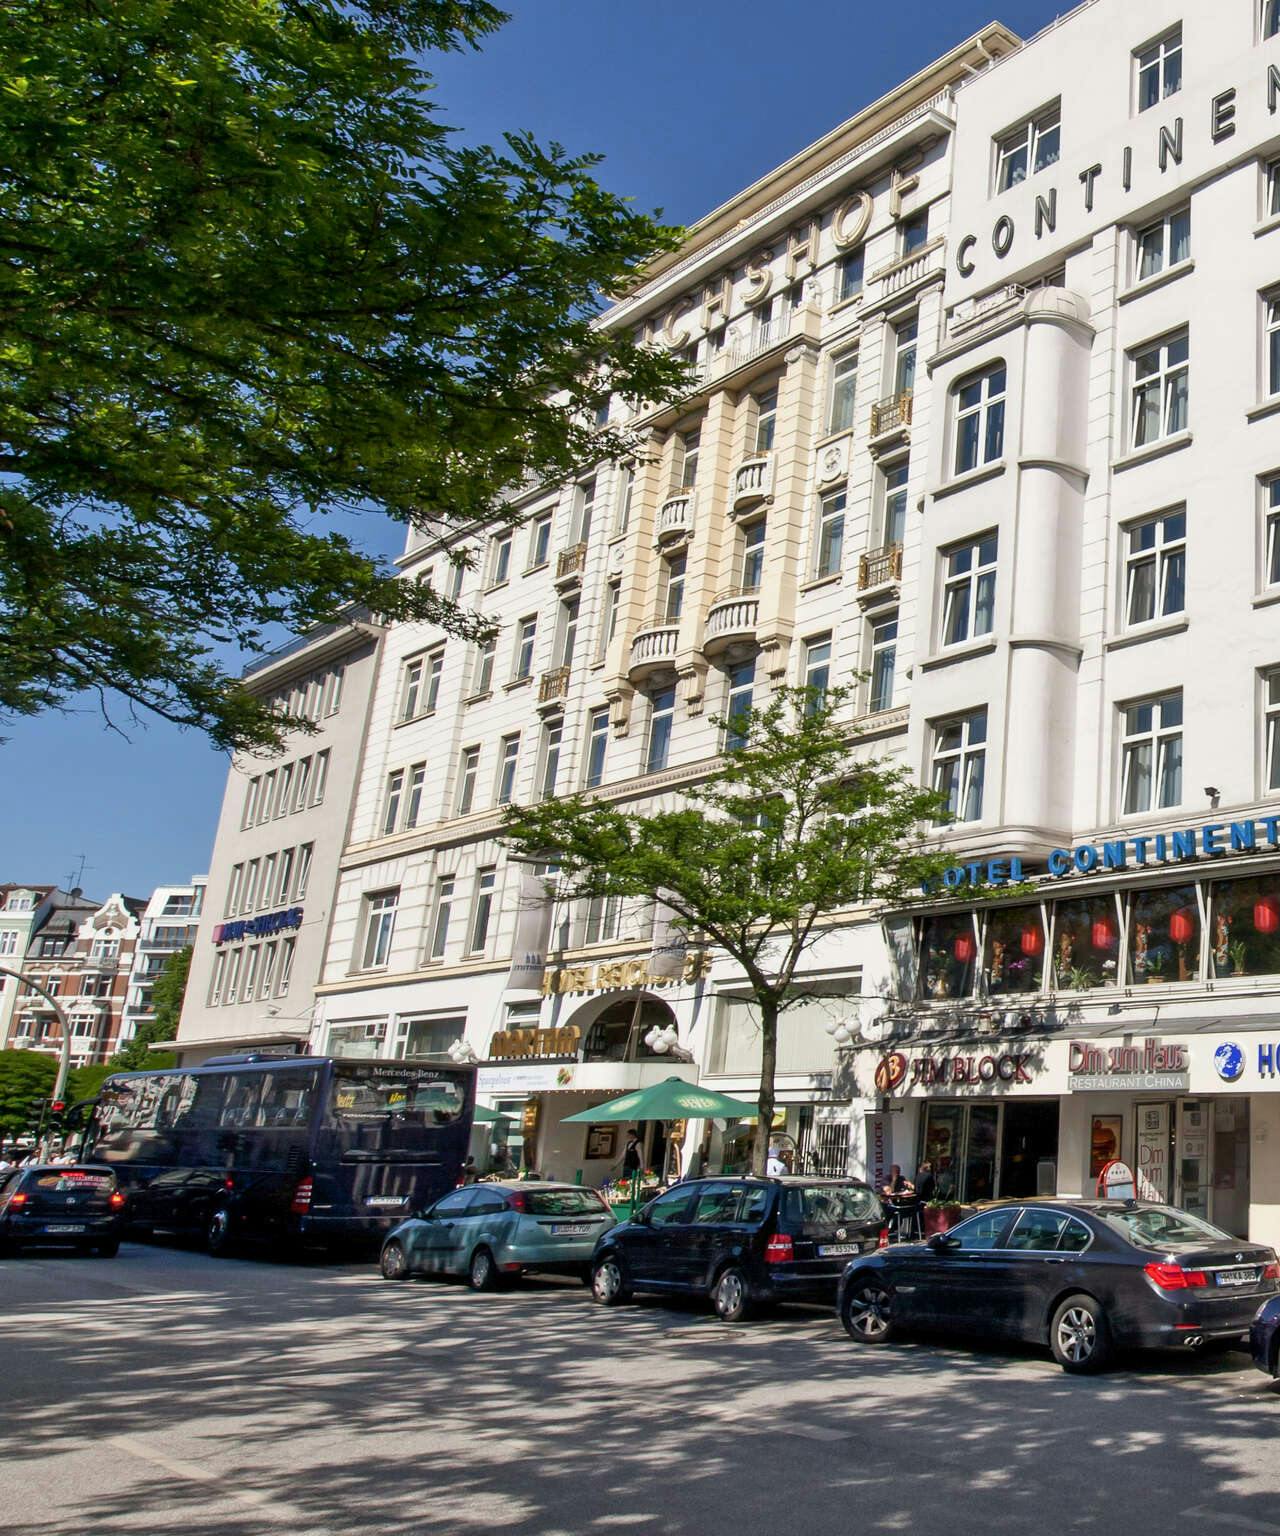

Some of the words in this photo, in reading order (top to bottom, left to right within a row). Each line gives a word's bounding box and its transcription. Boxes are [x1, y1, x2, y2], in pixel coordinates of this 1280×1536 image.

[640, 152, 924, 352] ICHSHOF
[922, 857, 1028, 893] OTEL
[910, 1056, 950, 1084] JIM
[951, 1053, 1033, 1084] BLOCK
[1069, 1077, 1141, 1089] RESTAURANT
[1144, 1075, 1183, 1088] CHINA
